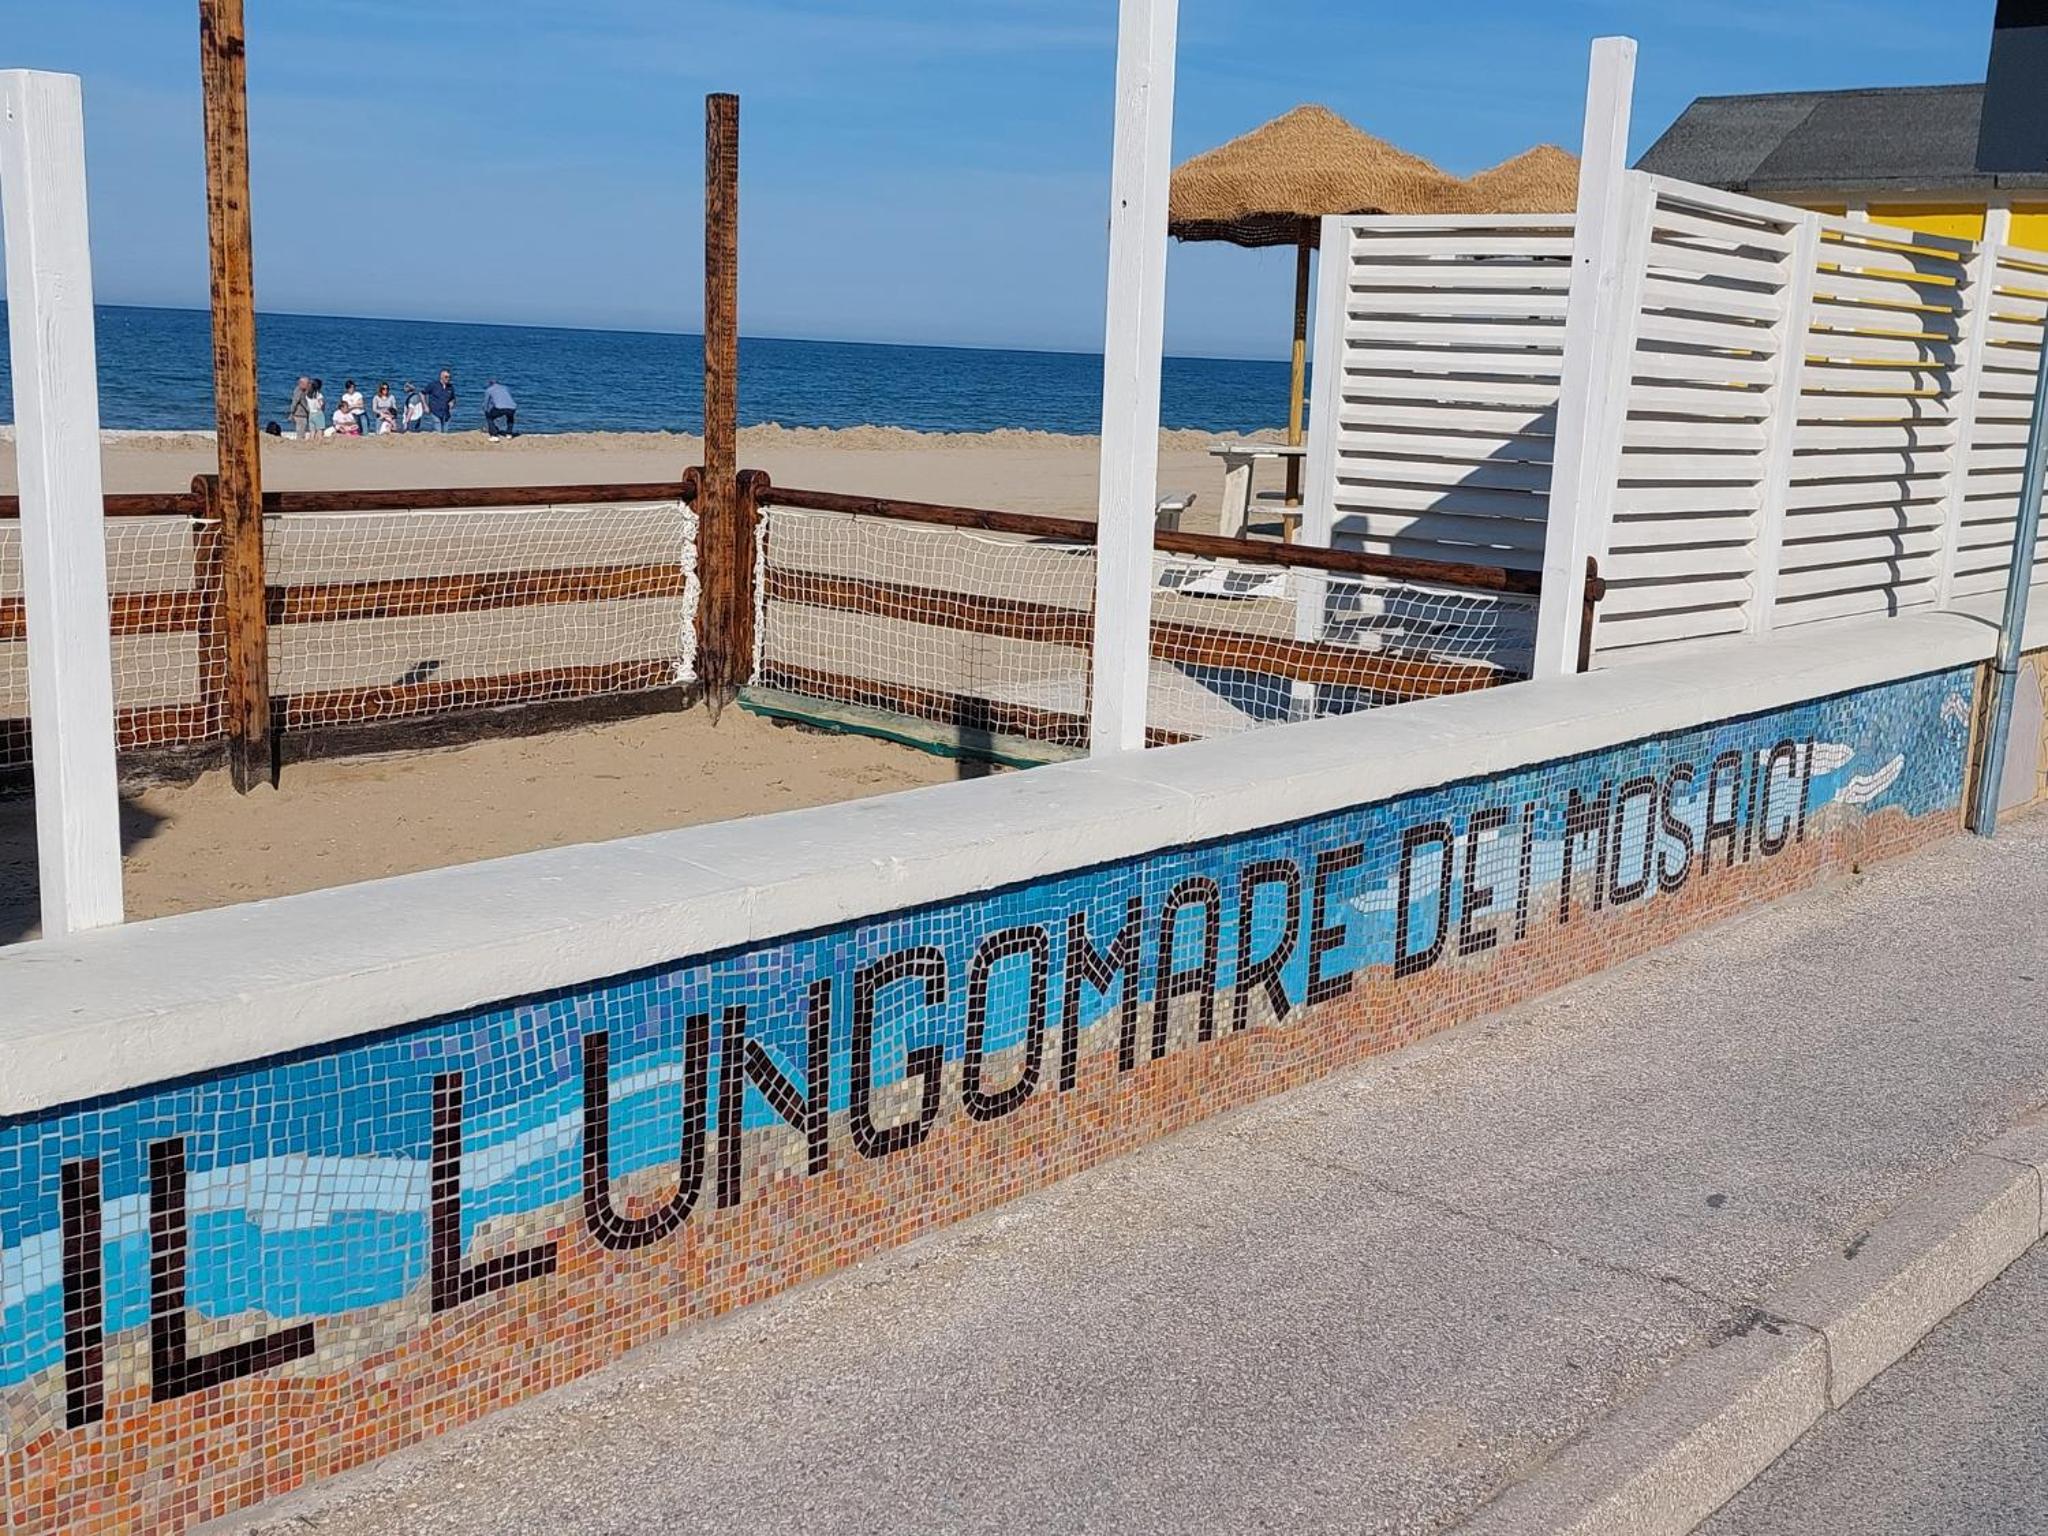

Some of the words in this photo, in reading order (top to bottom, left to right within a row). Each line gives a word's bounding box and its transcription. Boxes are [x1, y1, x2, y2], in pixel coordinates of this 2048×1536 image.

[62, 1137, 314, 1429] IL
[432, 843, 1364, 1312] LUNGOMARE
[1394, 802, 1533, 978] DEI
[1560, 735, 1813, 924] MOSAICI
